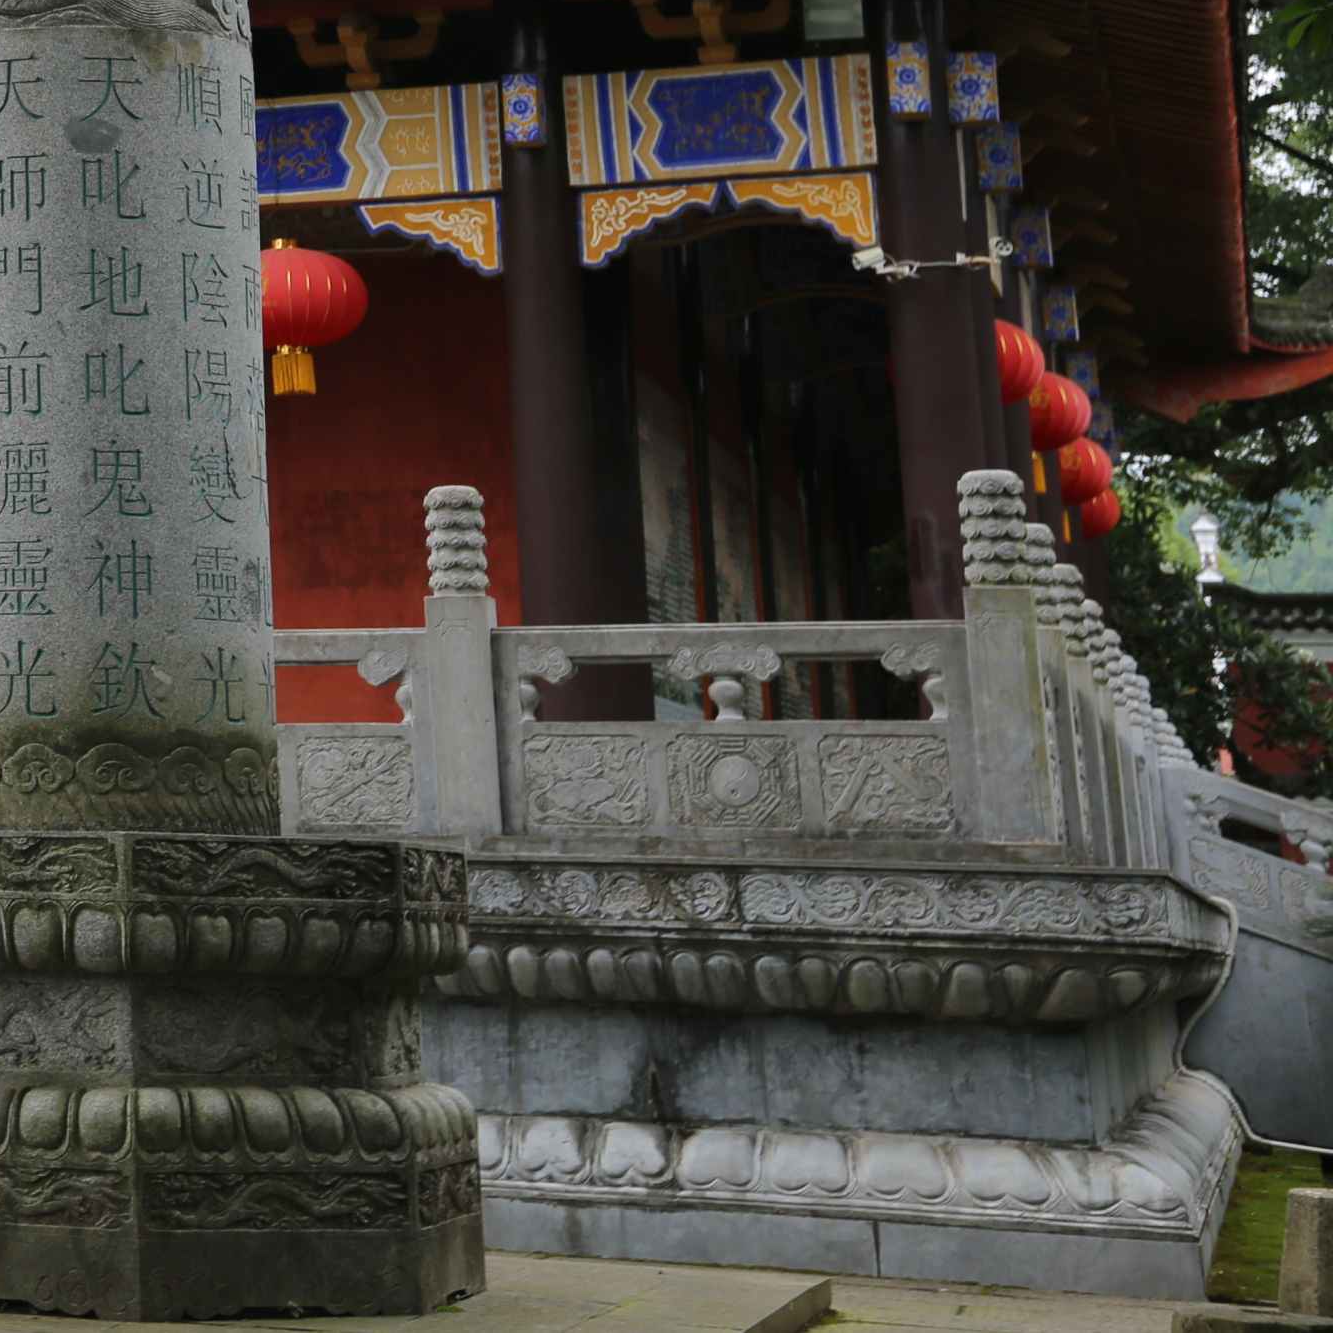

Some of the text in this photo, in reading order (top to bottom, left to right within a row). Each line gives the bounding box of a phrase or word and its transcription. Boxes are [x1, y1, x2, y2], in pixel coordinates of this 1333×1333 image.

[78, 56, 166, 720] 天叱地叱鬼神欽
[176, 62, 246, 724] 順逆陰陽變靈光
